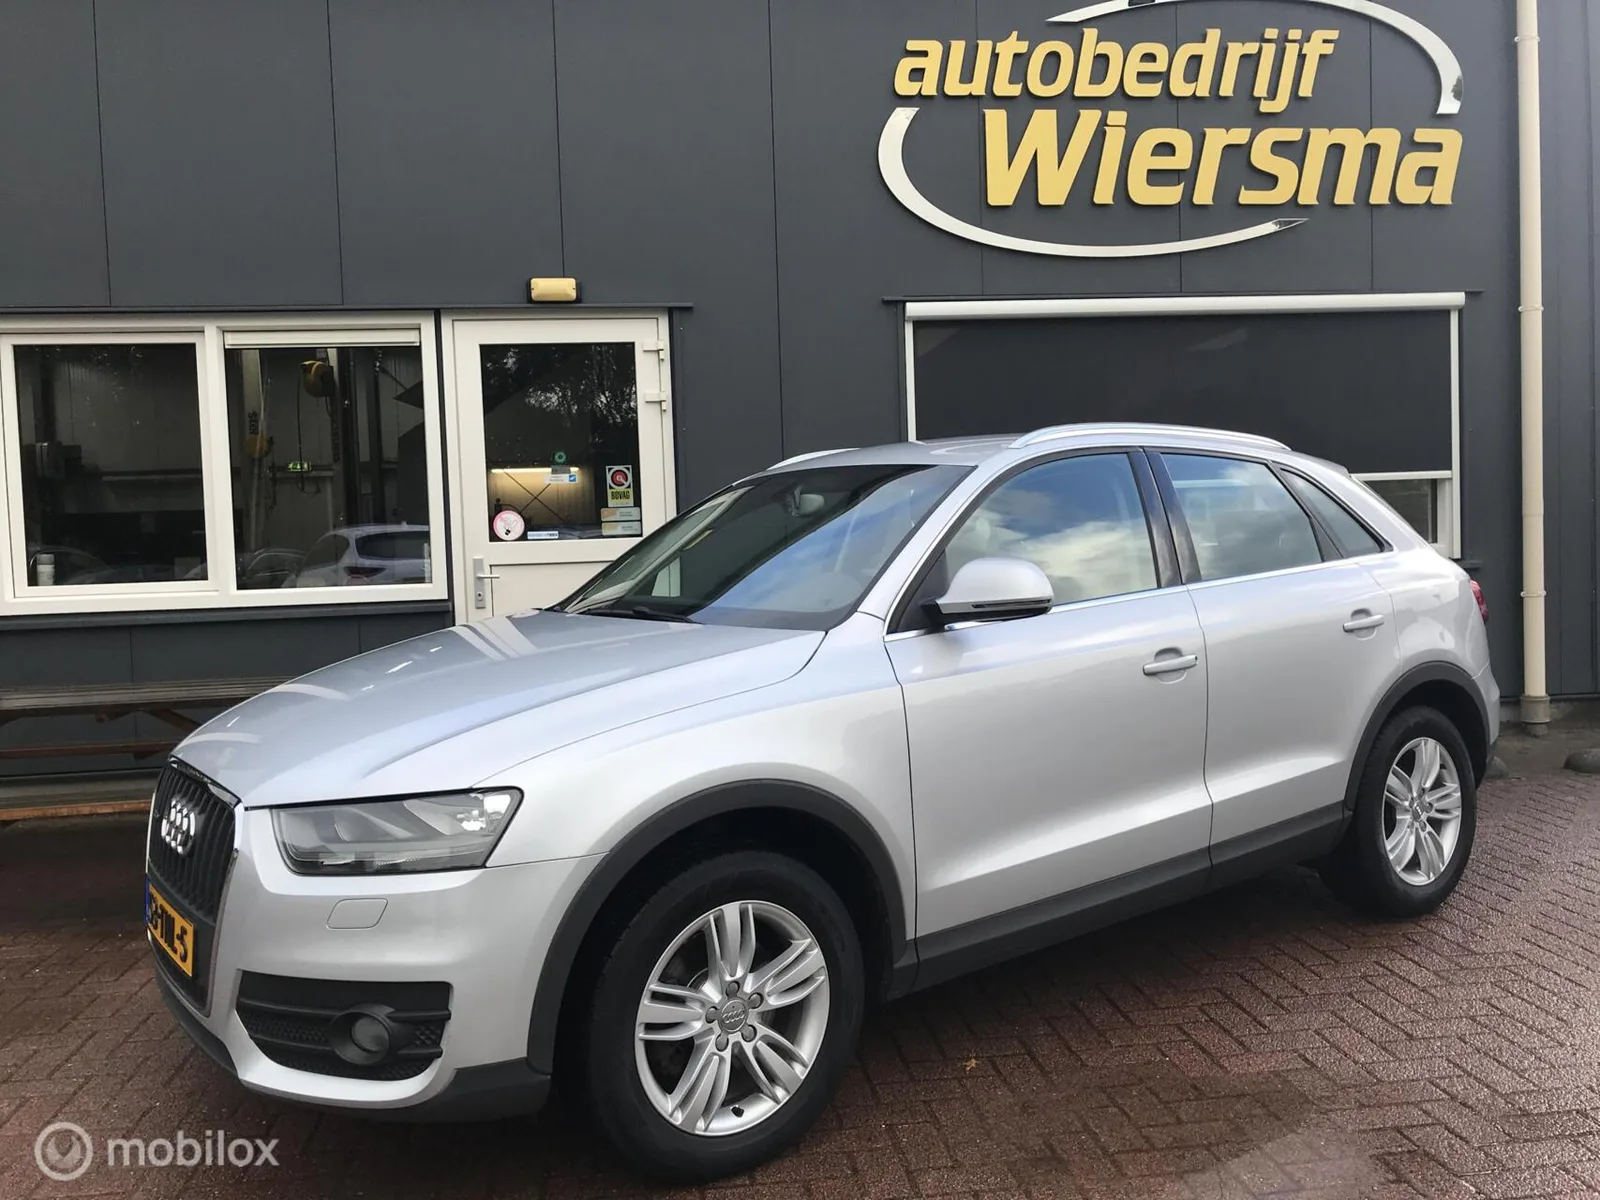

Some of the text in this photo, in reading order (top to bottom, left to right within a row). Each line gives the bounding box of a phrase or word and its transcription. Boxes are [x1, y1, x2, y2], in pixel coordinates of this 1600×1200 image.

[894, 28, 1340, 112] autobedrijf
[983, 109, 1463, 205] Wiersma
[610, 490, 631, 501] BOVAG
